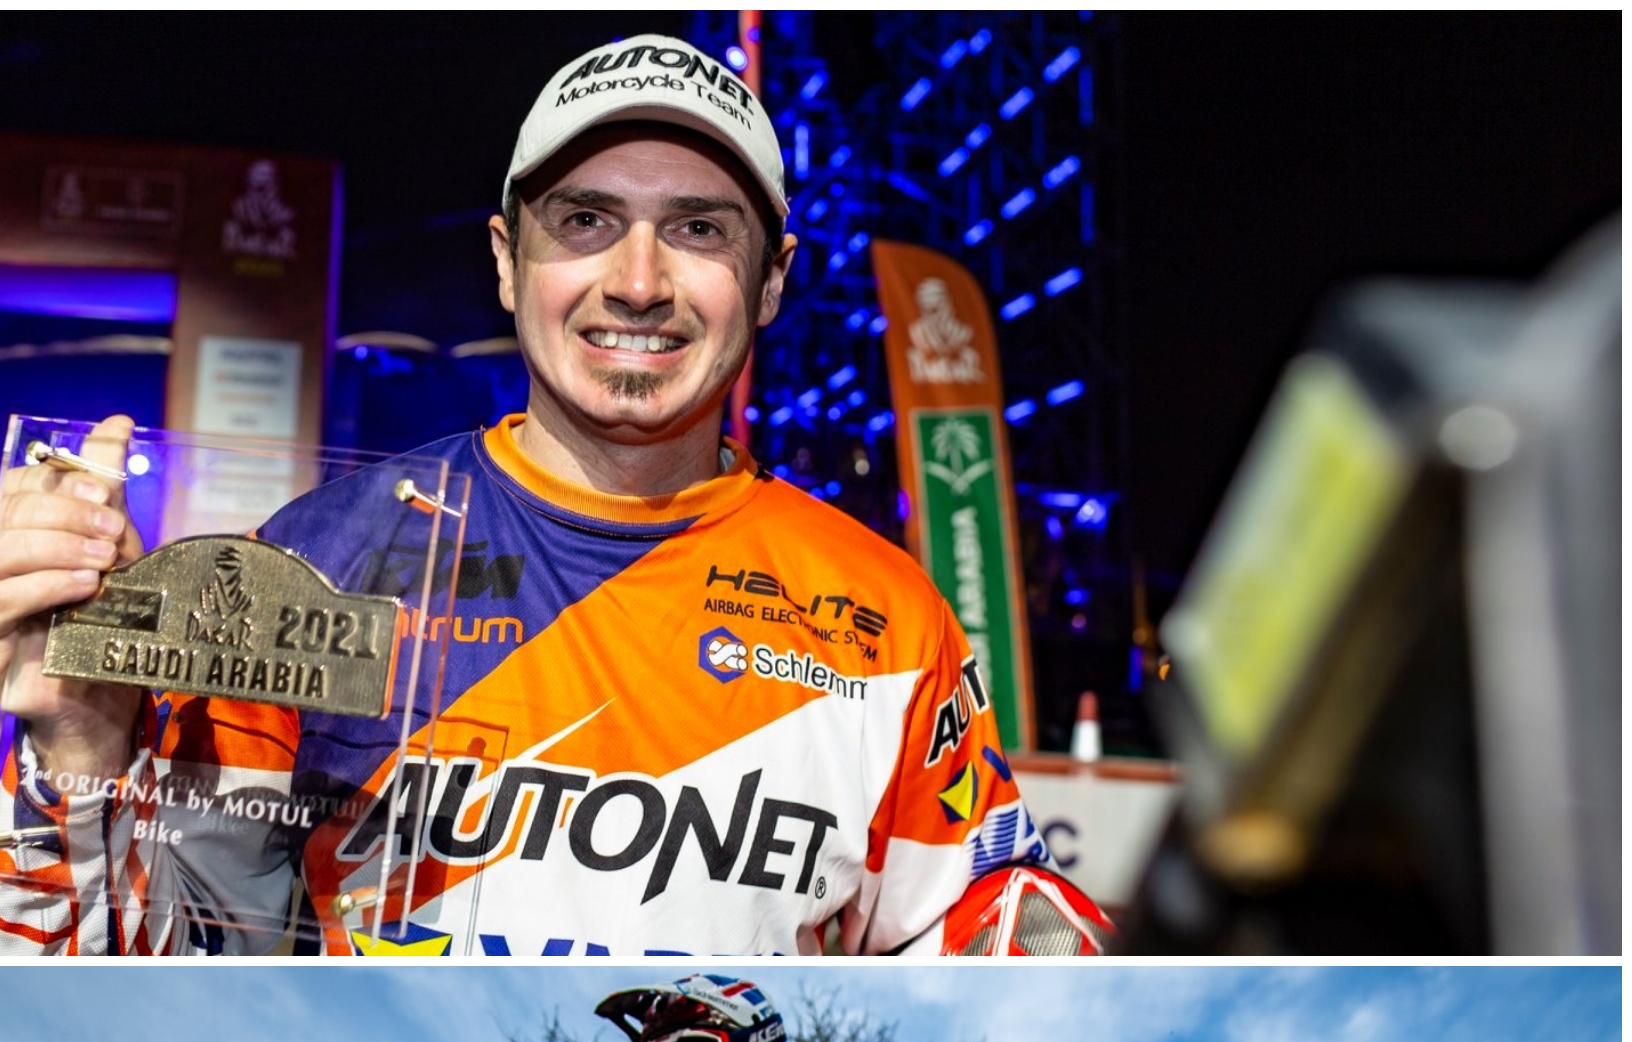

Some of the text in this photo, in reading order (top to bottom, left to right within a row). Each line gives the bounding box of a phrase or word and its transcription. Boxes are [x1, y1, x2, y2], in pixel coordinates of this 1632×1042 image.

[555, 73, 753, 130] Motorcycle Team
[559, 45, 754, 116] AUTONET
[275, 604, 379, 660] 2021
[704, 597, 755, 619] AIRBAG
[101, 641, 328, 700] SAUDI ARABIA
[54, 771, 178, 809] ORIGINAL
[185, 787, 215, 818] by
[221, 796, 313, 830] MOTUL
[132, 818, 184, 846] Bike
